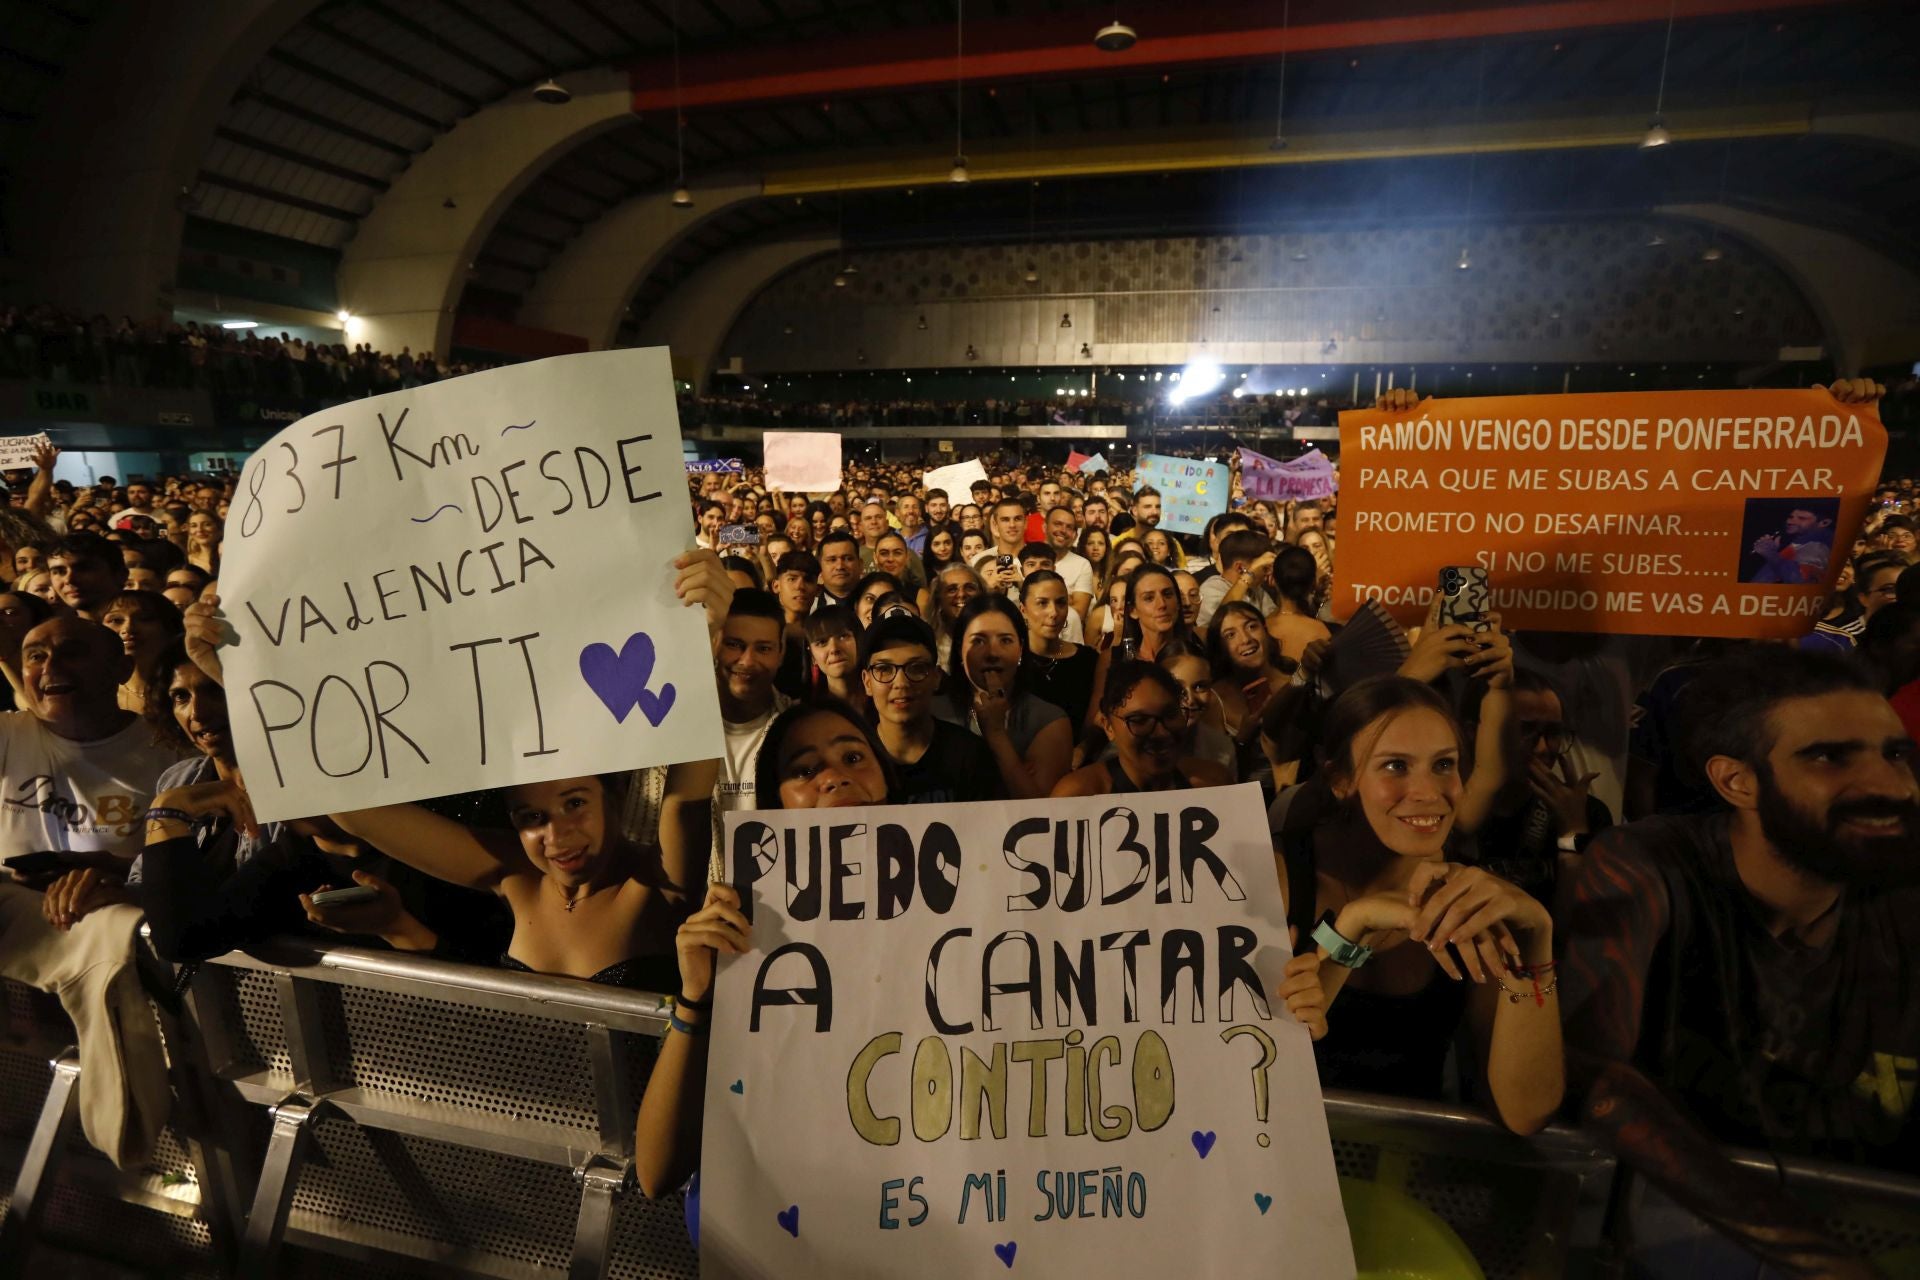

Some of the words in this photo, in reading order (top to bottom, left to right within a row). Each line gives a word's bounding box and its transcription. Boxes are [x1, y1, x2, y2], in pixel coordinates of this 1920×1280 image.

[37, 391, 89, 411] BAR
[1360, 414, 1452, 450] RAMÓN
[1459, 418, 1552, 450] VENGO
[1559, 418, 1649, 450] DESDE
[1656, 414, 1864, 451] PONFERRADA
[241, 425, 357, 537] 837
[377, 408, 480, 481] Km
[471, 434, 663, 533] DESDE
[1256, 476, 1274, 496] LA
[1279, 476, 1333, 496] PROMESA
[1360, 468, 1429, 489] PARA
[1439, 468, 1497, 493] QUE
[1507, 468, 1548, 490] ME
[1557, 468, 1649, 491] SUBAS
[1658, 469, 1680, 491] A
[1691, 468, 1845, 494] CANTAR,
[1354, 511, 1476, 533] PROMETO
[1485, 512, 1524, 534] NO
[1476, 550, 1496, 572] SI
[1506, 551, 1546, 573] NO
[1556, 553, 1593, 573] ME
[246, 537, 555, 646] VALENCIA
[1352, 584, 1436, 606] TOCAD
[1605, 591, 1643, 612] ME
[1652, 592, 1704, 614] VAS
[1711, 593, 1730, 615] A
[249, 660, 430, 788] POR
[449, 632, 559, 765] TI
[733, 820, 962, 926] PUEDO
[1003, 806, 1247, 912] SUBIR
[749, 942, 833, 1033] A
[925, 925, 1273, 1035] CANTAR
[880, 1176, 929, 1229] ES
[1034, 1166, 1147, 1222] SUEÑO
